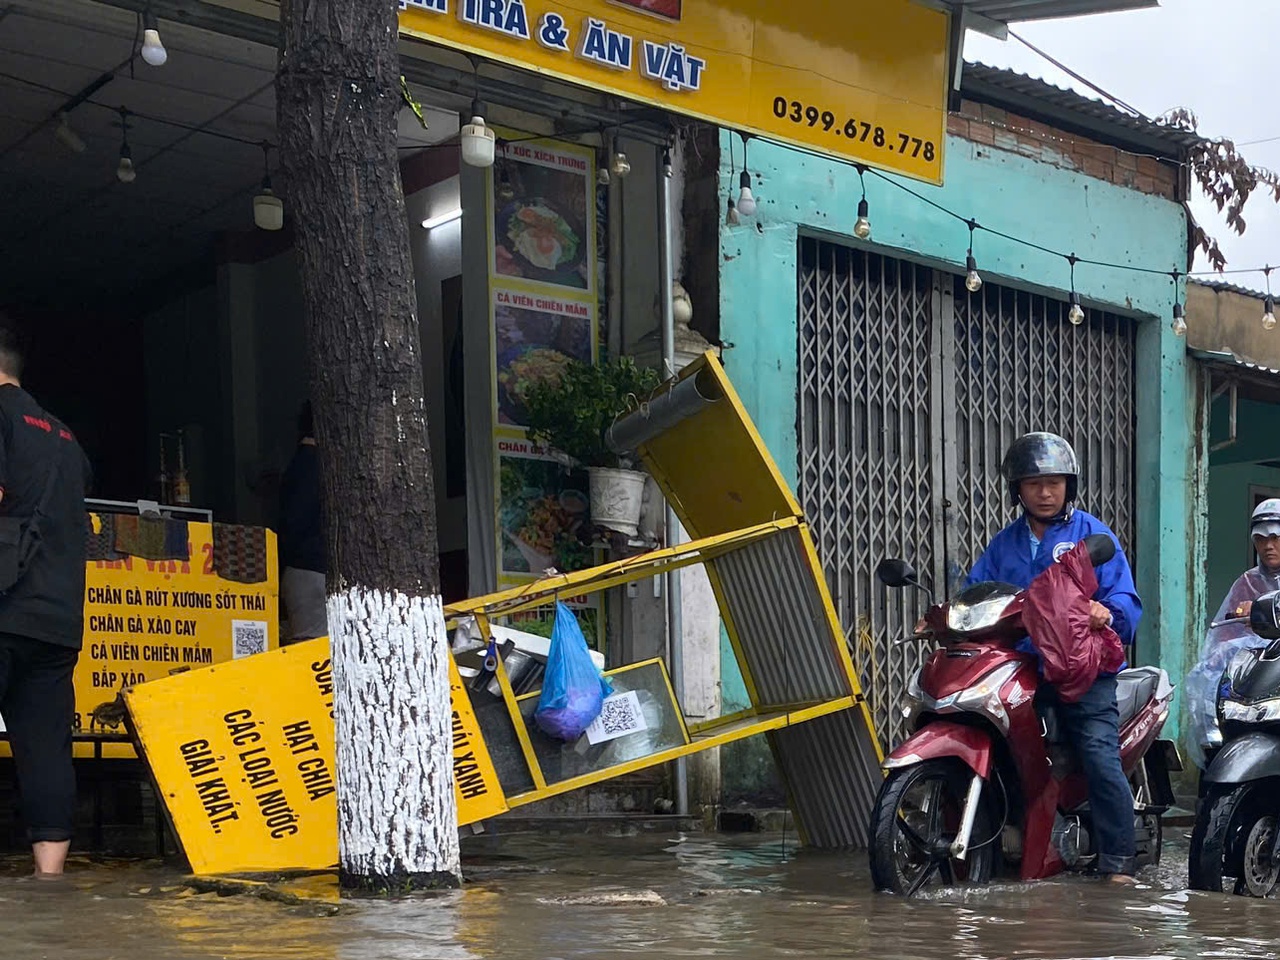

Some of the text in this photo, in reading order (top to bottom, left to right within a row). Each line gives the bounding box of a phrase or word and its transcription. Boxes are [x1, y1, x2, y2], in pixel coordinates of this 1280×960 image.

[540, 12, 570, 51] &
[581, 17, 633, 70] ĂN
[643, 40, 706, 91] VẶT
[773, 96, 935, 162] 0399.678.778
[87, 585, 266, 611] CHÂN GÀ RÚT XƯƠNG SỐT THÁI
[89, 614, 197, 636] CHÂN GÀ XÀO CAY
[91, 640, 108, 660] CÁ
[111, 643, 139, 661] VIÊN
[143, 643, 180, 663] CHIÊN
[179, 739, 226, 778] GIẢI
[223, 709, 300, 839] CÁC LOẠI NƯỚC
[282, 720, 336, 802] HẠT CHIA
[453, 751, 488, 800] XANH
